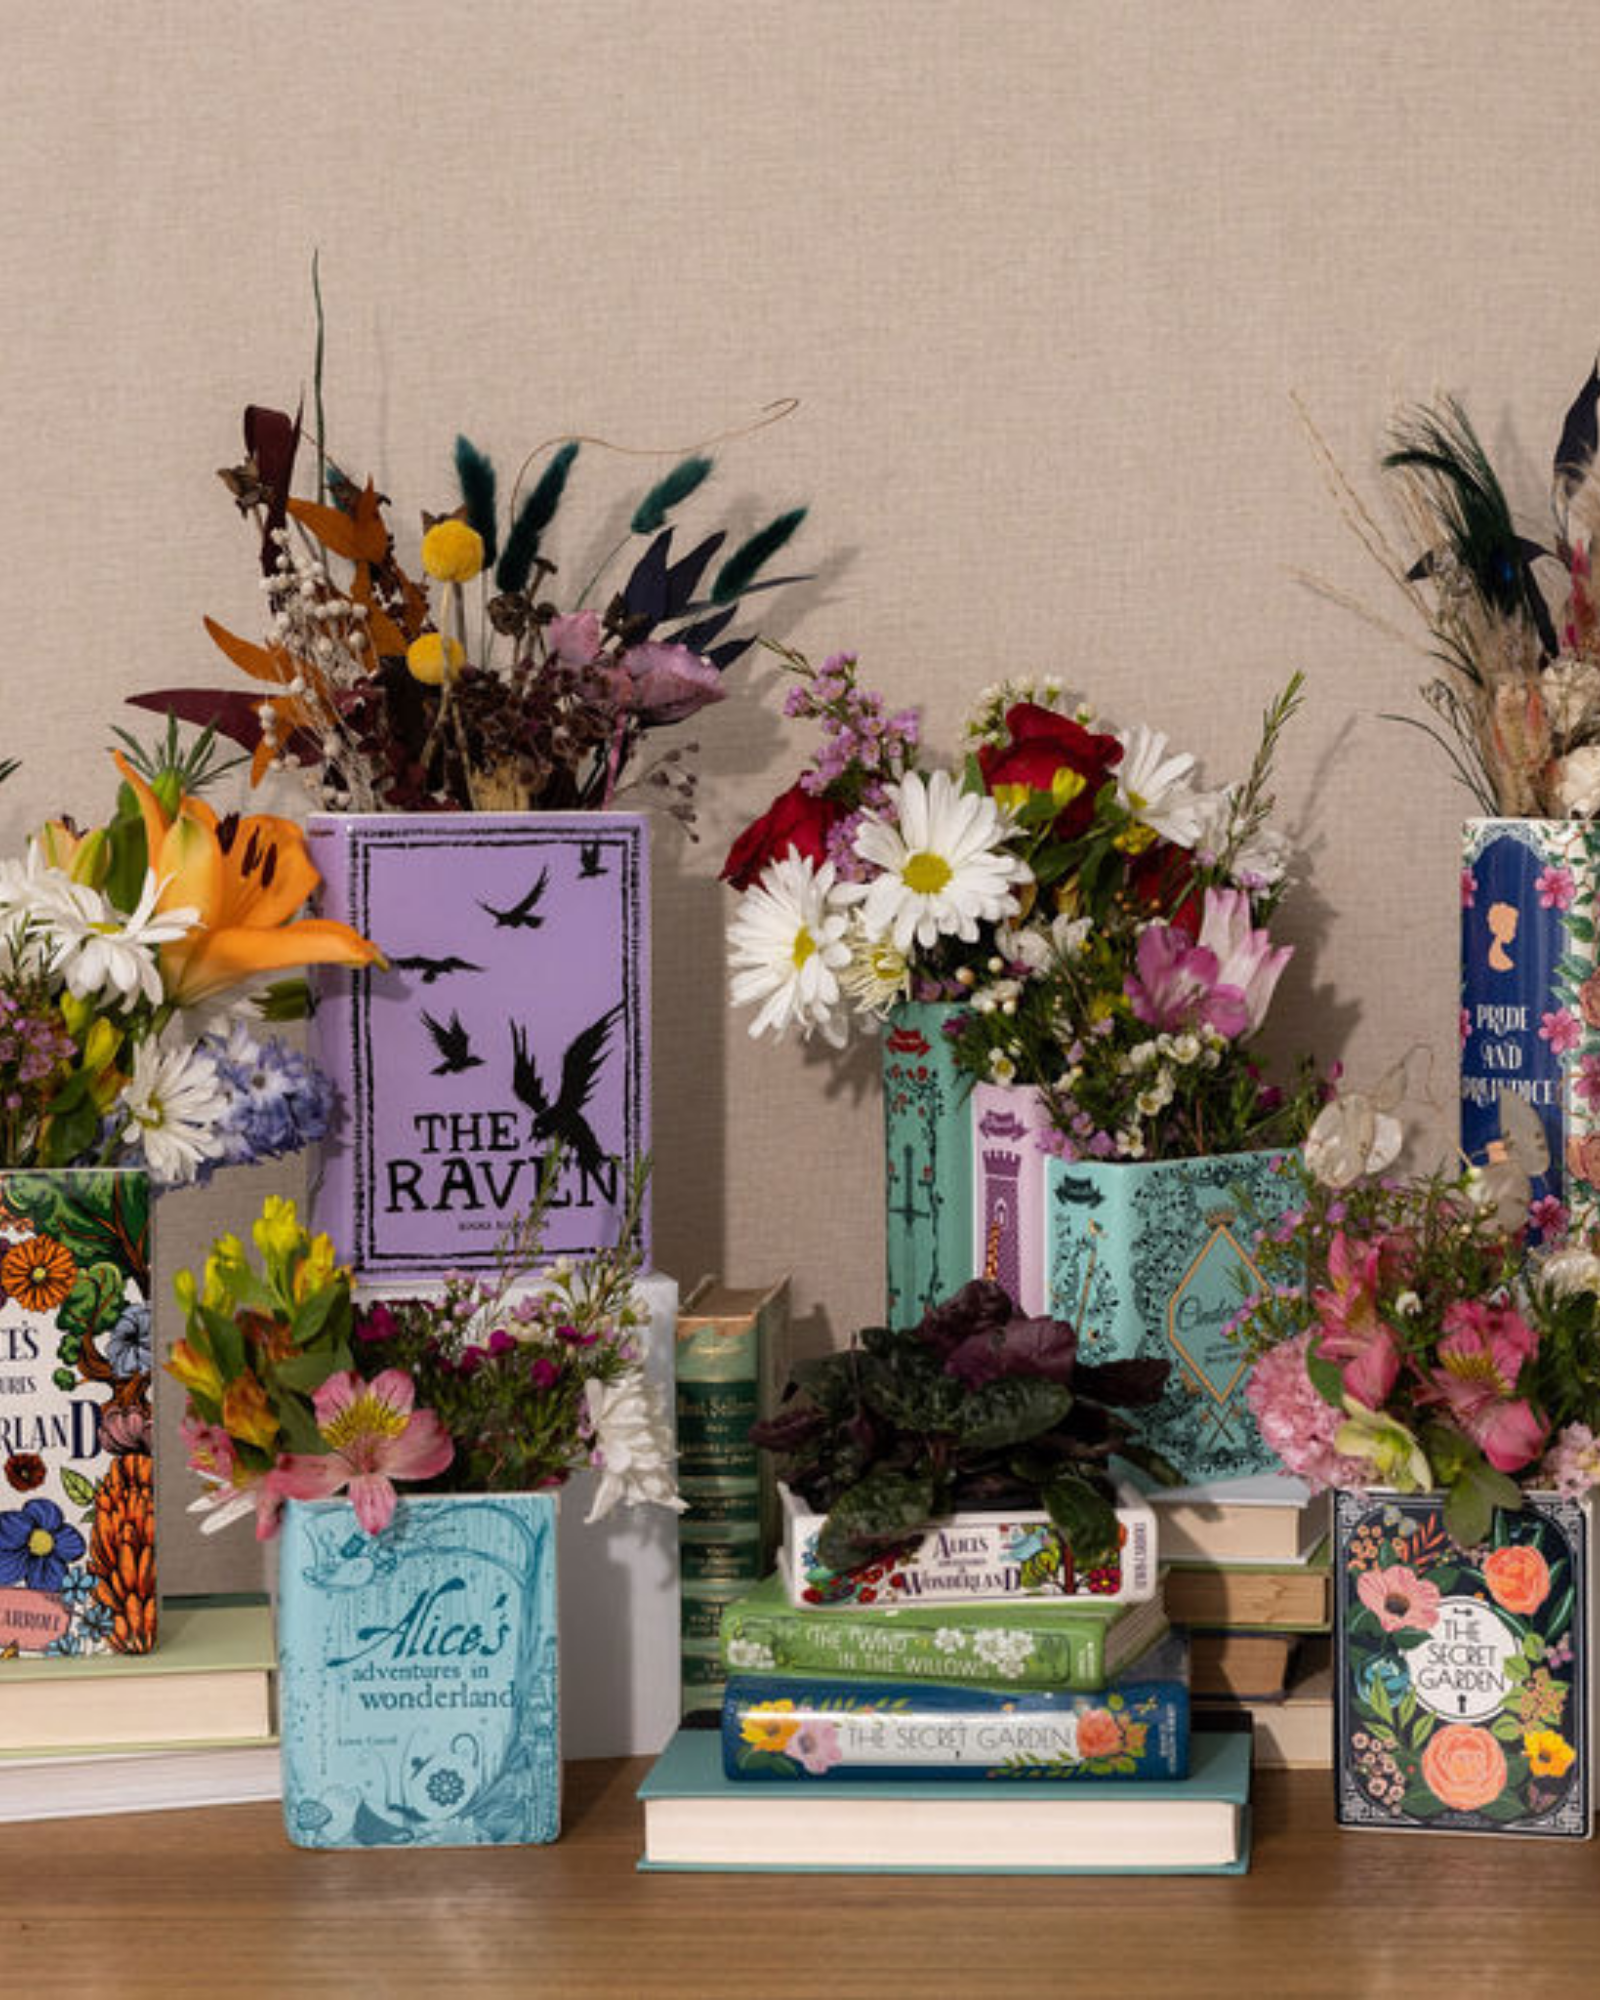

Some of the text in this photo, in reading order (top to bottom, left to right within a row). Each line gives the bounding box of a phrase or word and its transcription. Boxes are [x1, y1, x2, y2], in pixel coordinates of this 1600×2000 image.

[1476, 1004, 1531, 1037] PRIDE
[1481, 1038, 1522, 1070] AND
[413, 1112, 520, 1154] THE
[384, 1155, 622, 1213] RAVEN
[0, 1320, 39, 1362] E'S
[900, 1566, 1022, 1595] WONDERLAND
[326, 1577, 511, 1667] Alice's
[1443, 1619, 1480, 1642] THE
[807, 1622, 907, 1654] THE WIND
[839, 1651, 989, 1677] IN THE WILLOWS
[1427, 1643, 1498, 1667] SECRET
[352, 1661, 490, 1681] adventures in
[1418, 1667, 1504, 1692] GARDEN
[358, 1680, 517, 1710] wonderland
[849, 1721, 1072, 1750] THE SECRET GARDEN
